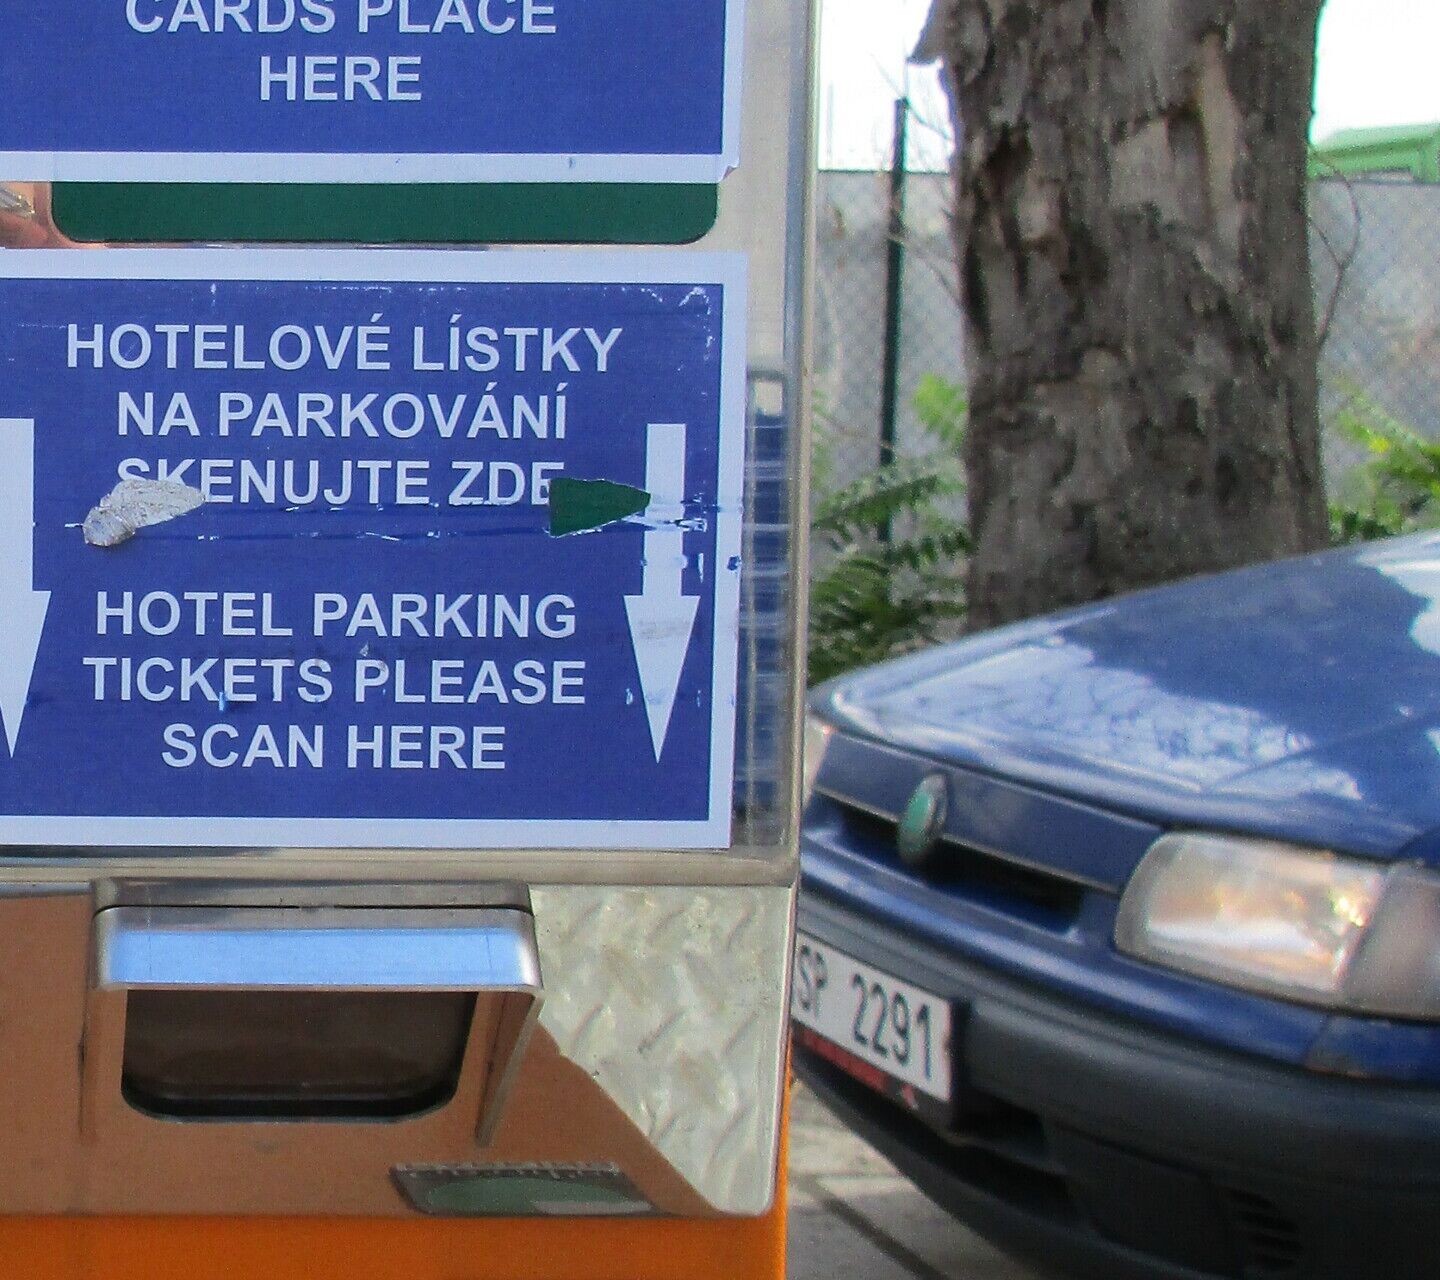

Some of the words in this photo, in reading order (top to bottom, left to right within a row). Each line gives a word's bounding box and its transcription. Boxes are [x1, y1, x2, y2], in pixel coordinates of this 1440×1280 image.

[260, 56, 422, 101] HERE
[67, 314, 391, 370] HOTELOVÉ
[413, 315, 623, 372] LÍSTKY
[118, 391, 201, 437] NA
[219, 383, 568, 439] PARKOVÁNÍ
[448, 461, 565, 506] ZDE
[96, 591, 293, 636] HOTEL
[313, 592, 577, 639] PARKING
[82, 657, 333, 703] TICKETS
[355, 659, 586, 705] PLEASE
[161, 723, 324, 768] SCAN
[347, 725, 507, 769] HERE
[852, 972, 933, 1082] 2291
